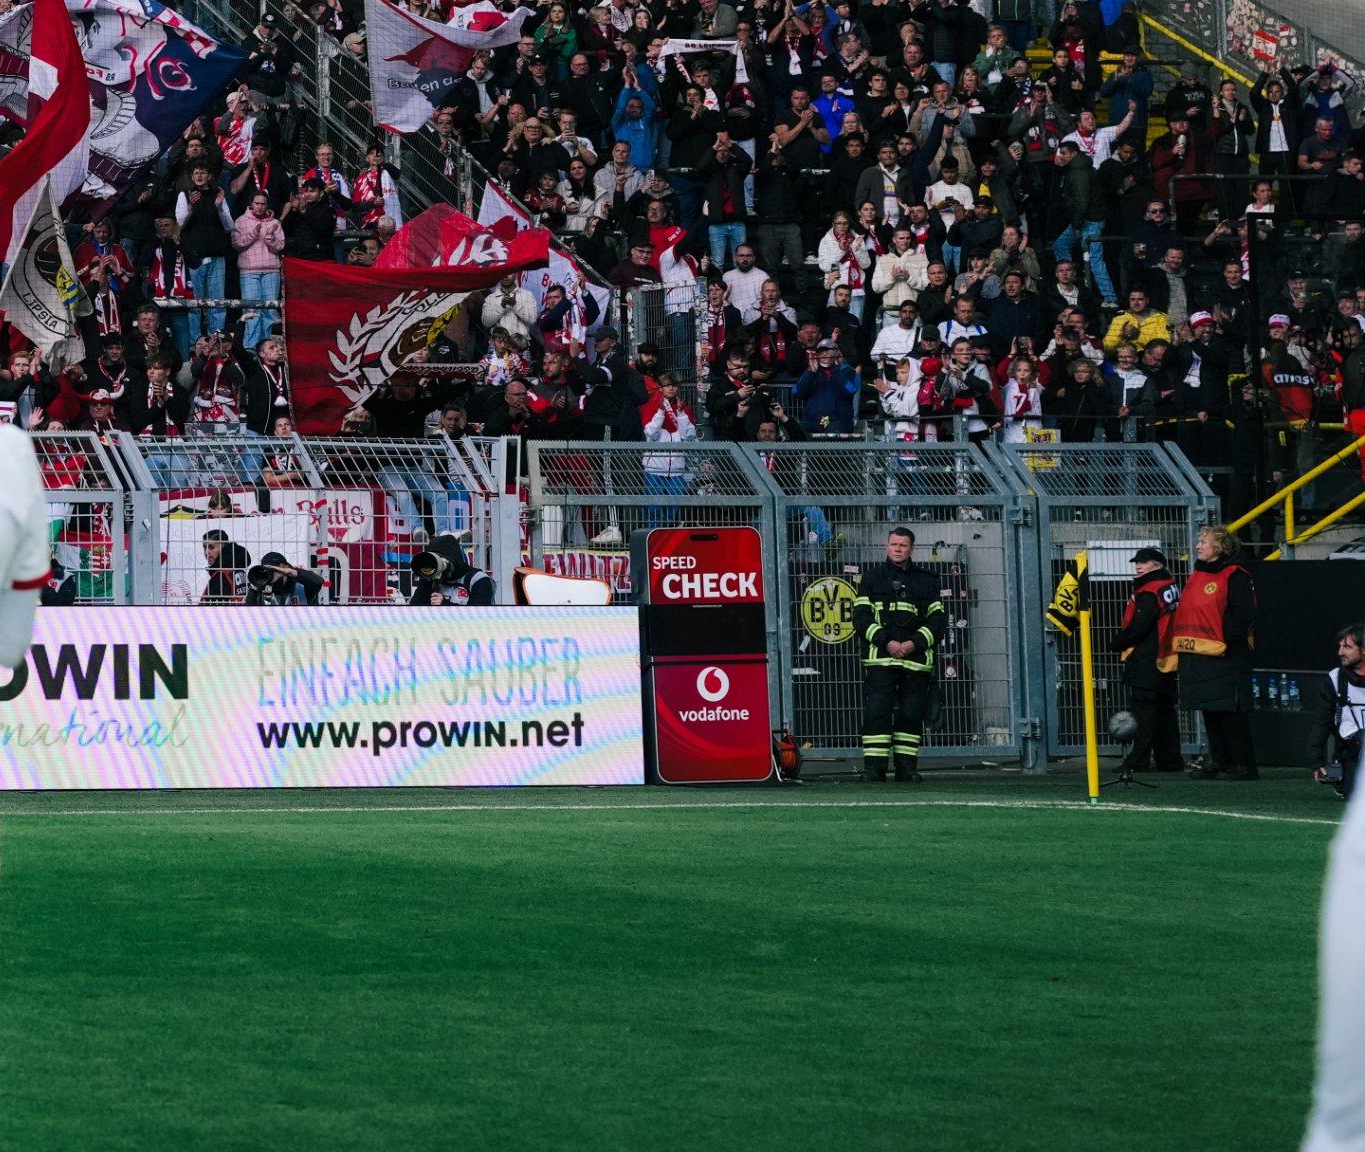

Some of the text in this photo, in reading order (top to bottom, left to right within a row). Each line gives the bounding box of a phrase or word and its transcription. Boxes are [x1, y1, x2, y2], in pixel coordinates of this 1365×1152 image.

[22, 292, 59, 331] LIPSIA
[653, 555, 697, 571] SPEED
[663, 573, 758, 600] CHECK
[256, 636, 583, 709] EINFACH SAUBER
[679, 704, 750, 724] vodafone
